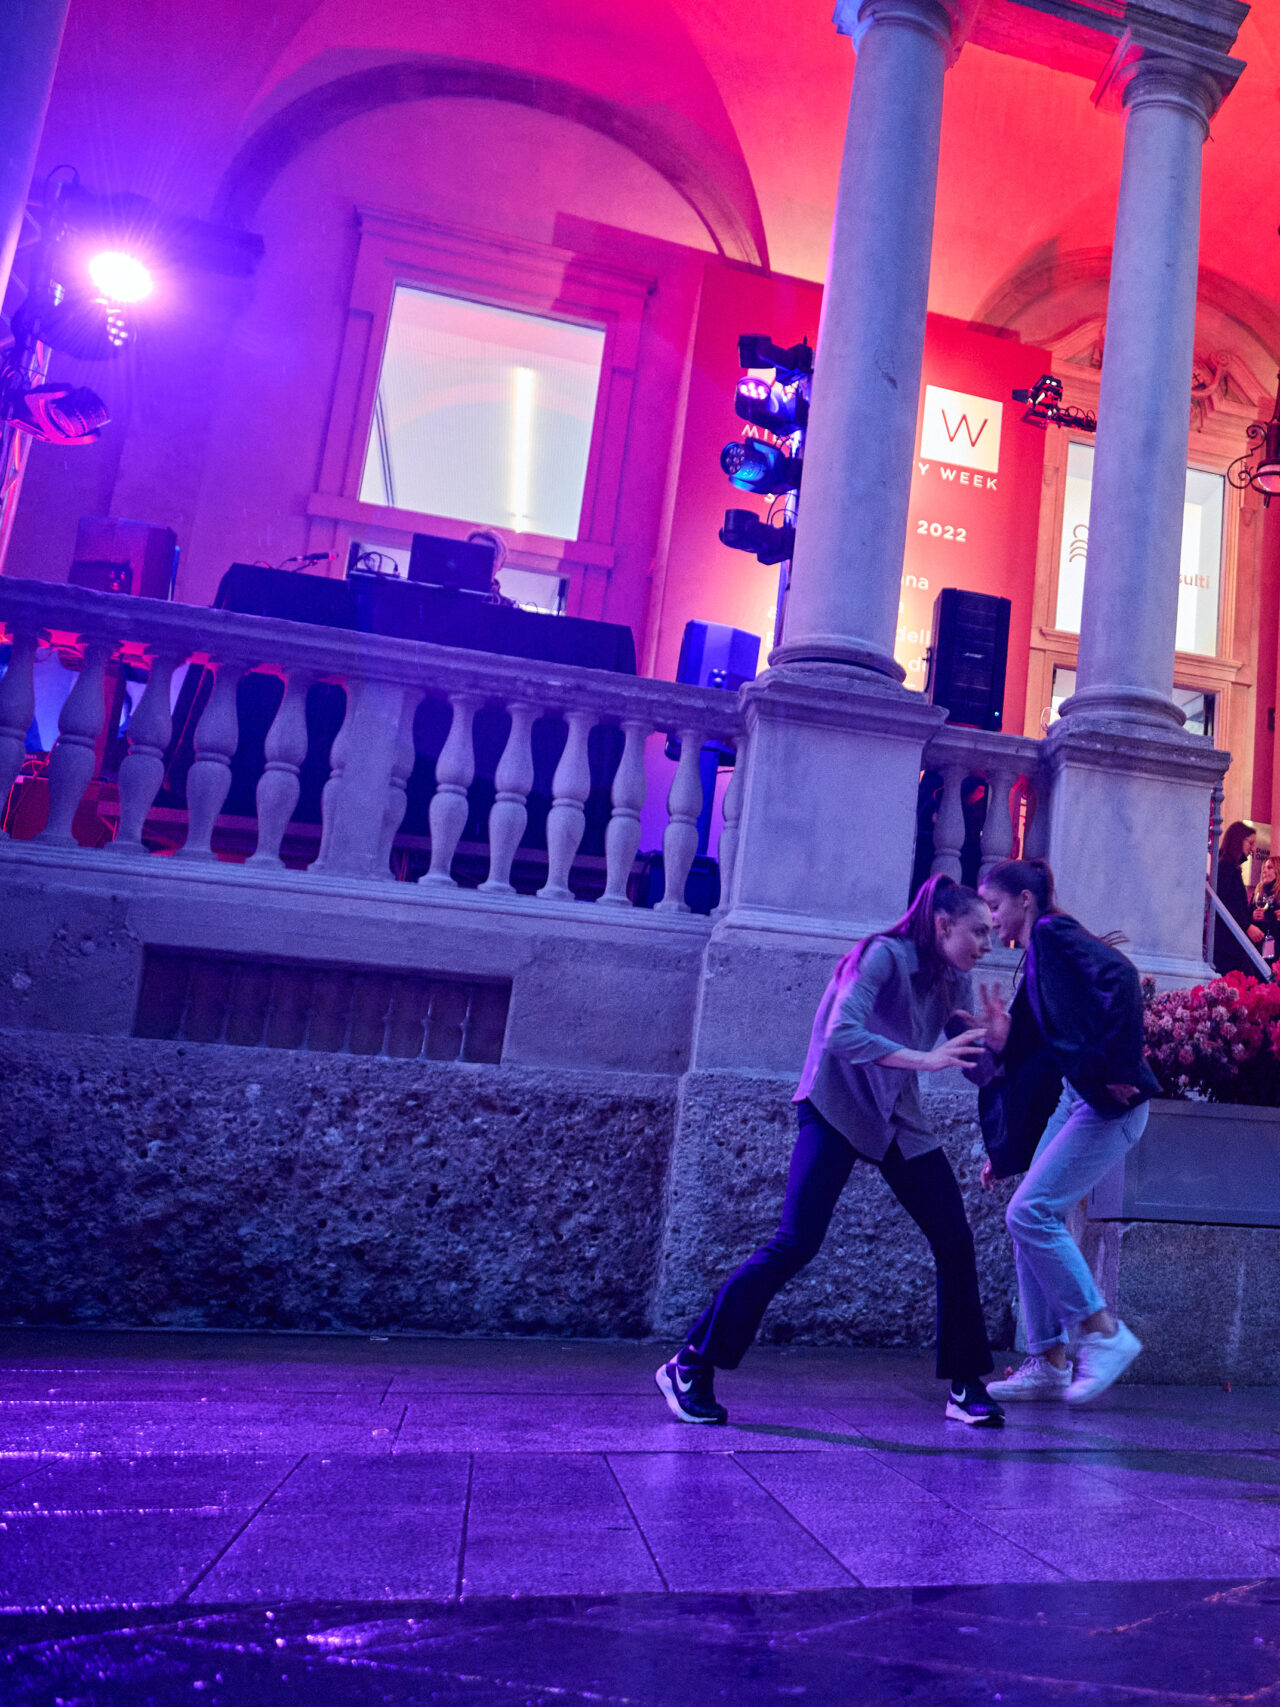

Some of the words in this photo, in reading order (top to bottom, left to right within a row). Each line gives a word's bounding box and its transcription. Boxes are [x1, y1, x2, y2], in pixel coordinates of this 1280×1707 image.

[941, 408, 988, 447] W
[940, 466, 998, 490] WEEK
[917, 520, 967, 542] 2022
